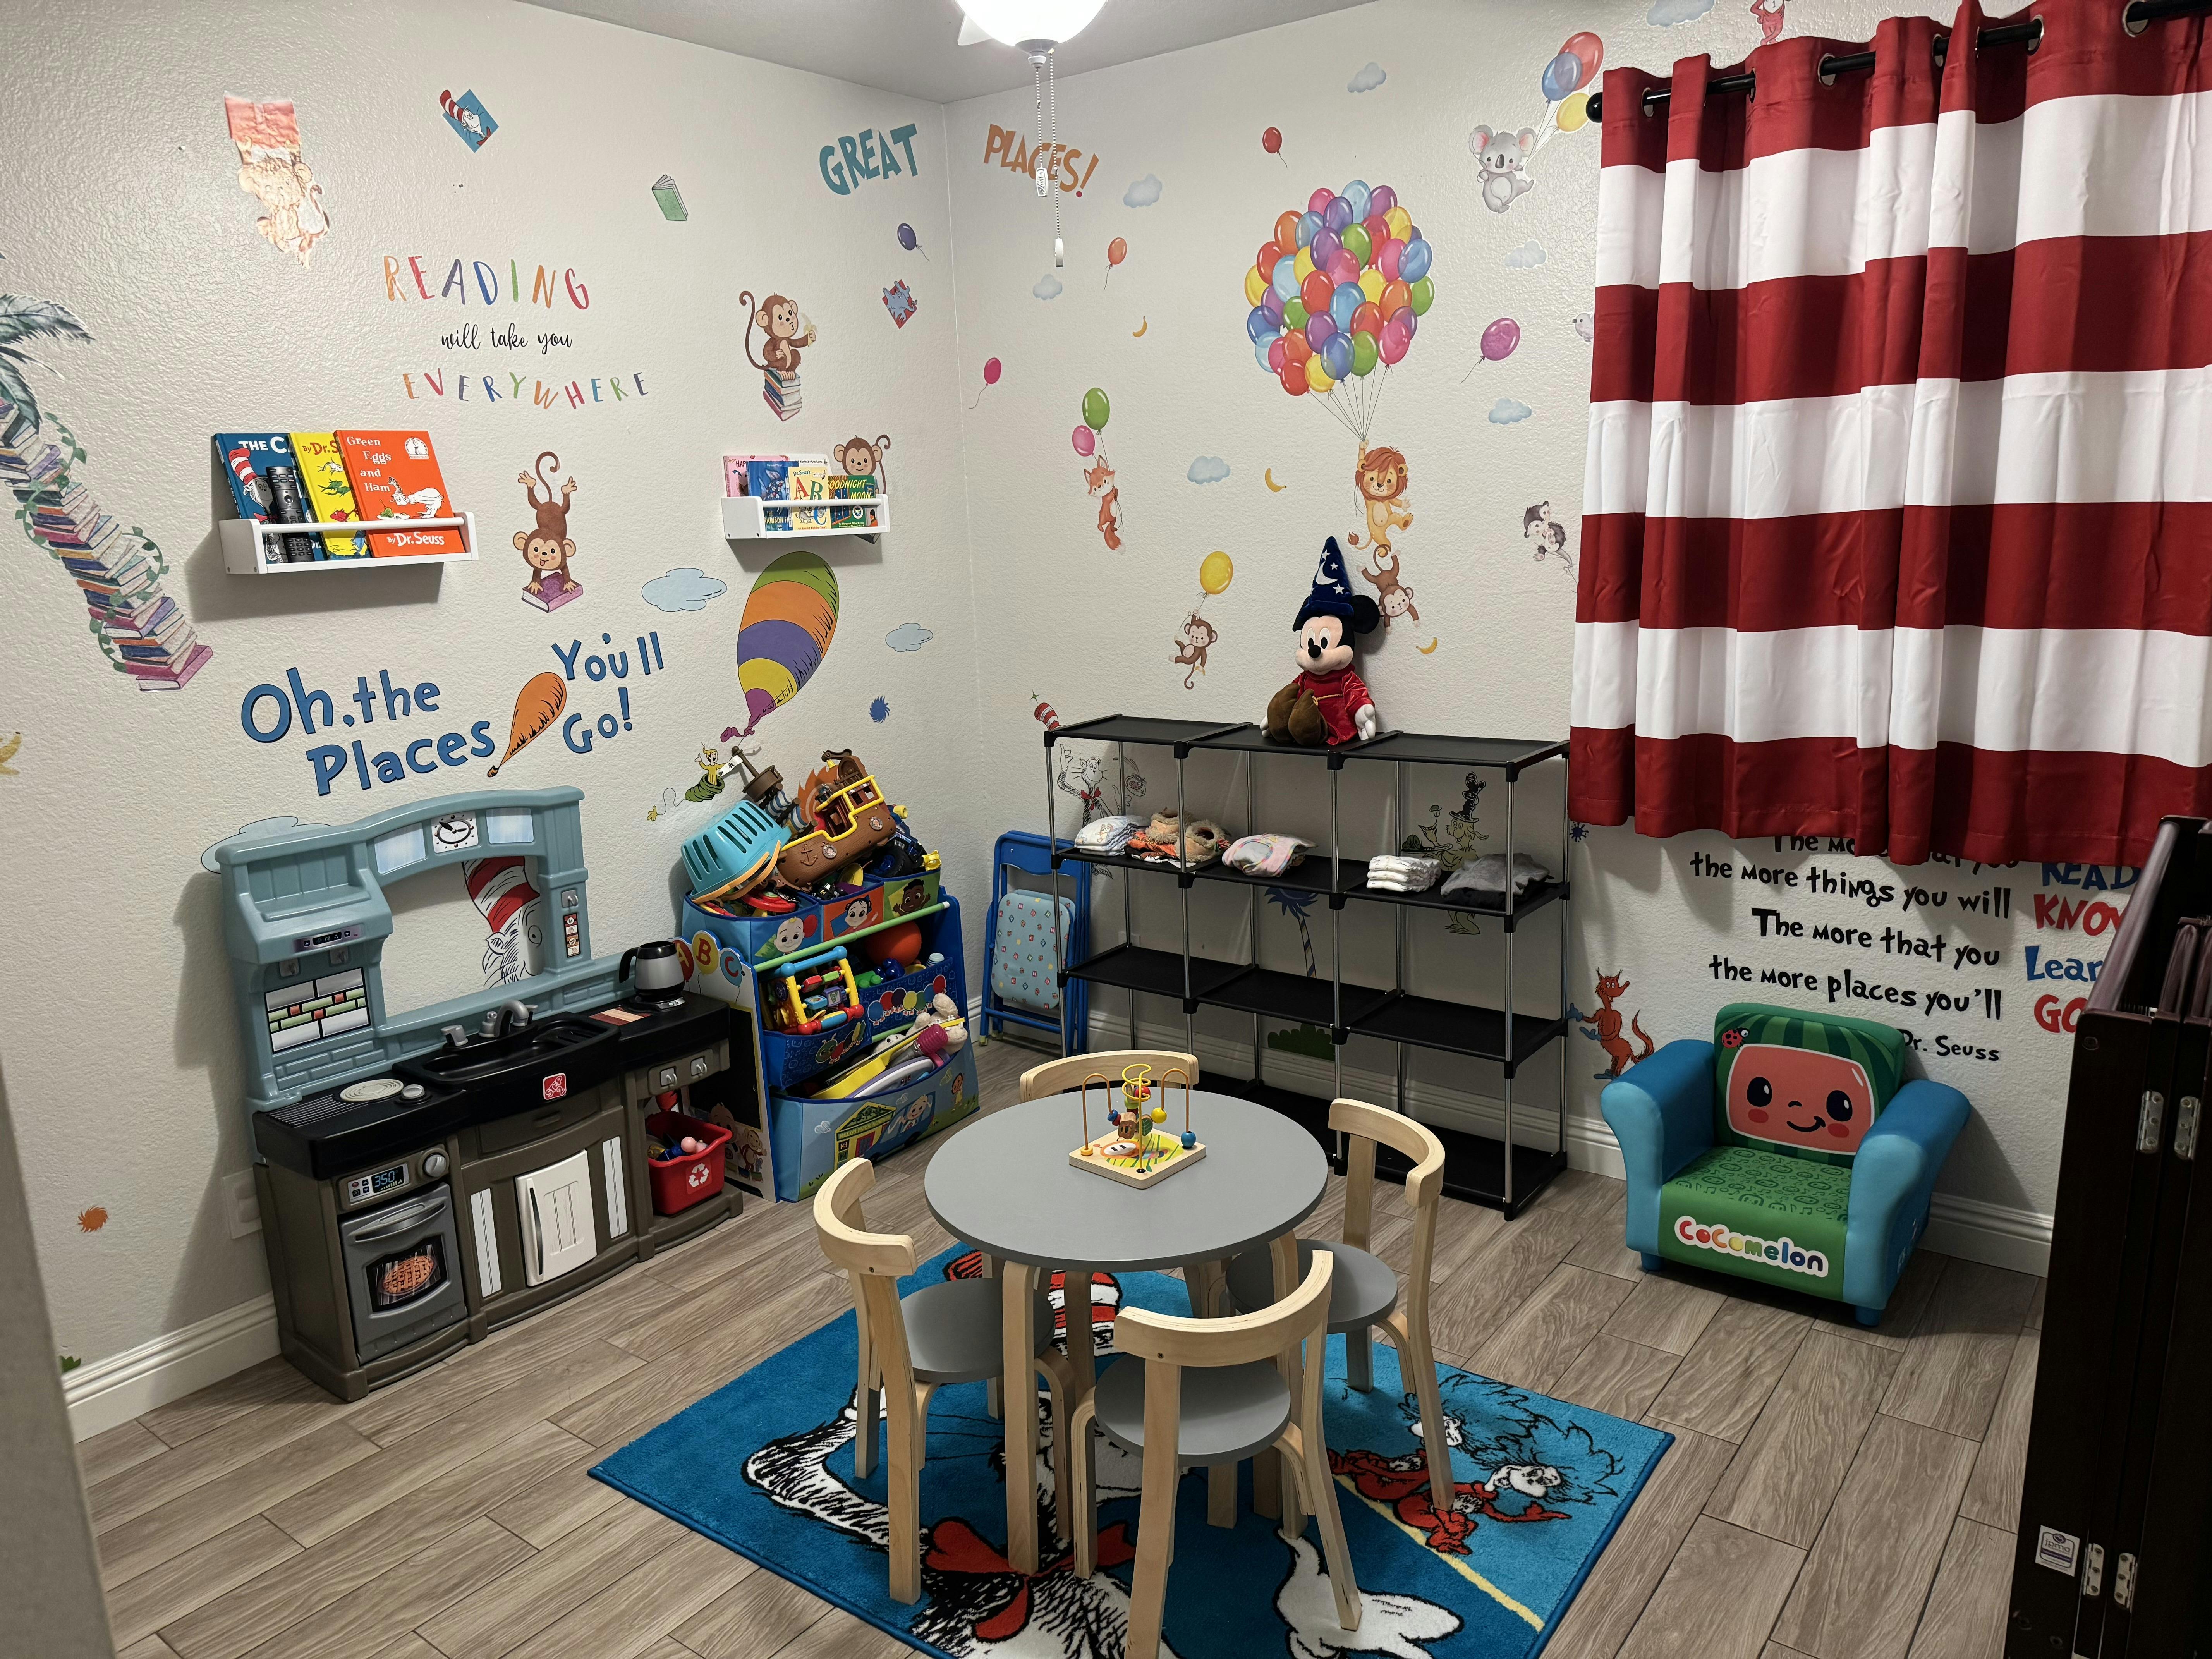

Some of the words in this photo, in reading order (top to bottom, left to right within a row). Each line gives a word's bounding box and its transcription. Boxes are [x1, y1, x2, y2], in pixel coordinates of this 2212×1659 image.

[819, 123, 918, 196] GREAT
[983, 123, 1100, 198] PLACES!
[383, 254, 589, 310] READING
[441, 323, 481, 350] will
[490, 323, 529, 349] take
[537, 332, 573, 355] you
[402, 368, 649, 410] EVERYWHERE
[238, 440, 269, 451] THE
[310, 442, 330, 455] Dr.
[346, 436, 381, 446] Green
[362, 450, 392, 465] Eggs
[359, 468, 382, 477] and
[363, 483, 391, 492] Ham
[393, 533, 414, 547] Dr.
[413, 531, 445, 545] Seuss
[551, 631, 665, 682] You'll
[353, 669, 441, 725] the
[562, 686, 633, 754] Go!
[306, 720, 495, 797] Places
[1689, 851, 1733, 879] the
[1902, 886, 1948, 912] you
[1957, 886, 2011, 919] will
[1751, 907, 1804, 937] The
[1879, 926, 1947, 963] that
[1953, 945, 2000, 971] you
[676, 943, 689, 967] A
[696, 938, 711, 965] B
[724, 956, 739, 977] C
[1708, 954, 1752, 982] the
[1827, 969, 1917, 1007] places
[1924, 988, 2002, 1020] you'll
[1935, 1035, 2000, 1061] Seuss
[545, 1075, 563, 1098] STEP
[556, 1085, 565, 1095] 2
